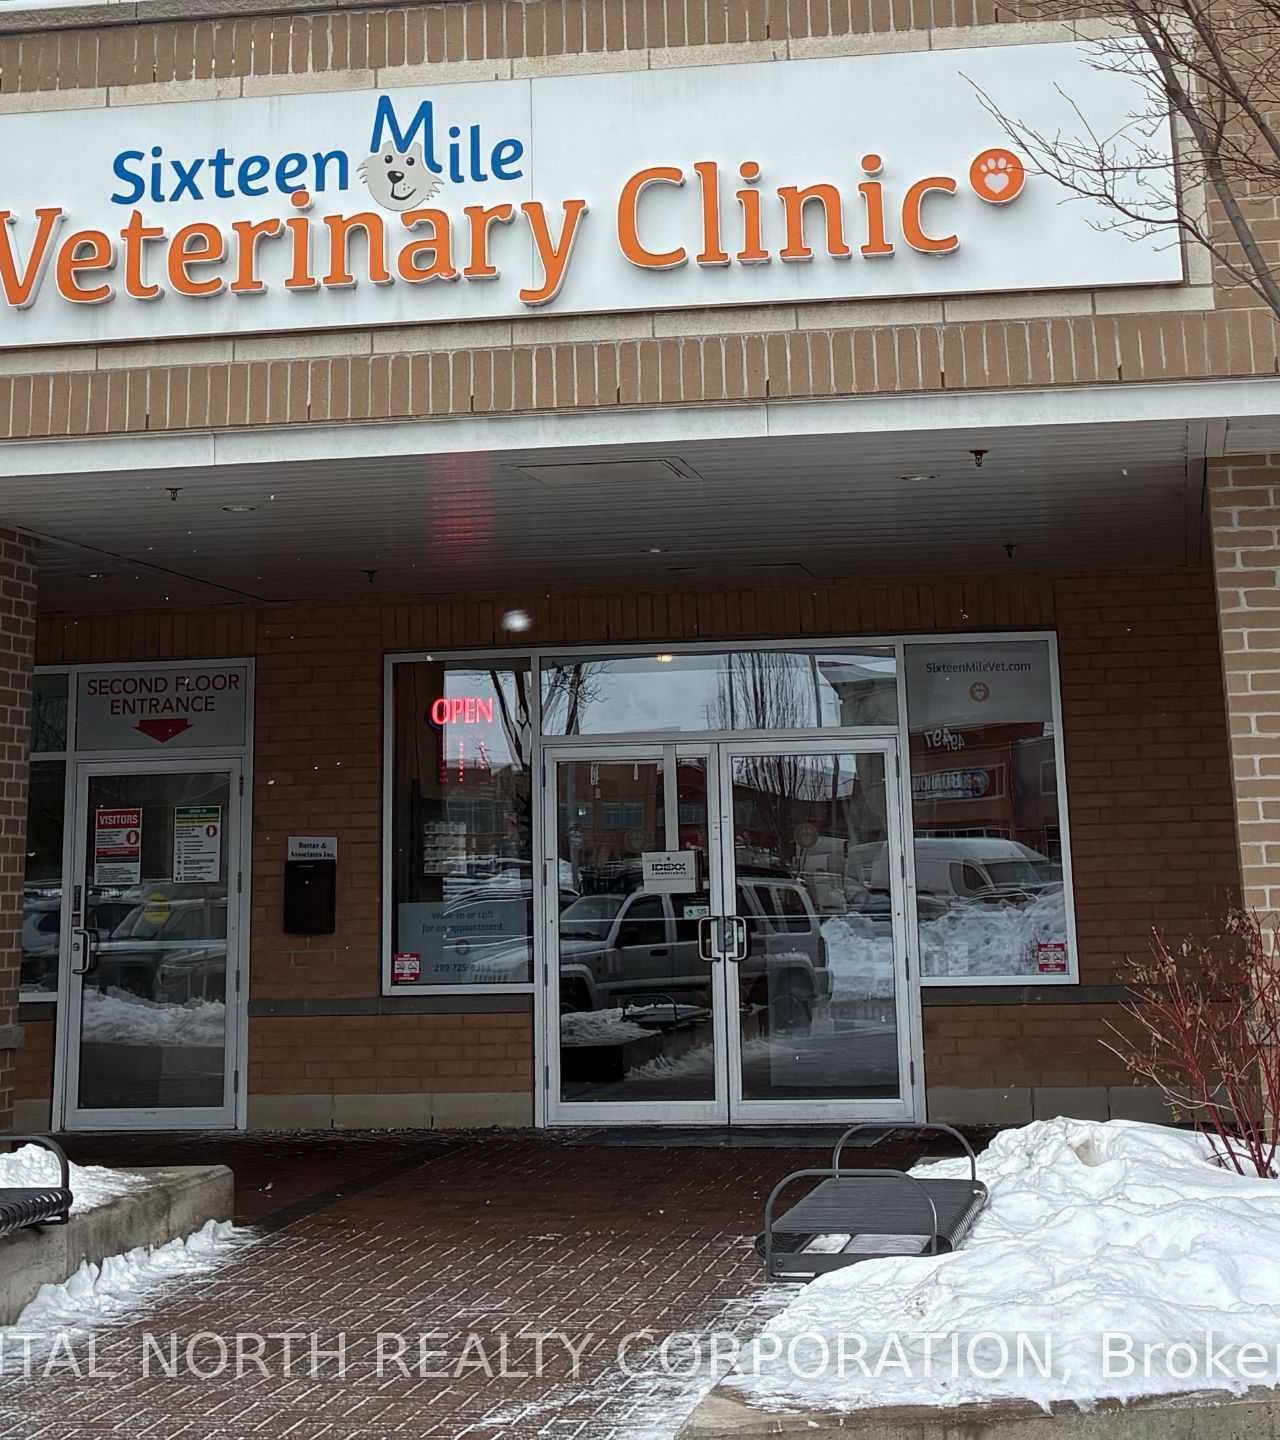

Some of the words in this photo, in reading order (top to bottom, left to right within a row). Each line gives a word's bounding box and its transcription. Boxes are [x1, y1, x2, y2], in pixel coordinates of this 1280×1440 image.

[109, 145, 350, 206] Sixteen
[369, 94, 525, 185] Mile
[616, 153, 960, 271] Clinic
[925, 662, 1032, 674] SixteenMileVet.com
[87, 676, 168, 696] SECOND
[175, 673, 240, 692] FLOOR
[109, 695, 216, 716] ENTRANCE
[431, 696, 494, 725] OPEN
[99, 814, 139, 826] VISITORS
[651, 862, 686, 871] IDEXX
